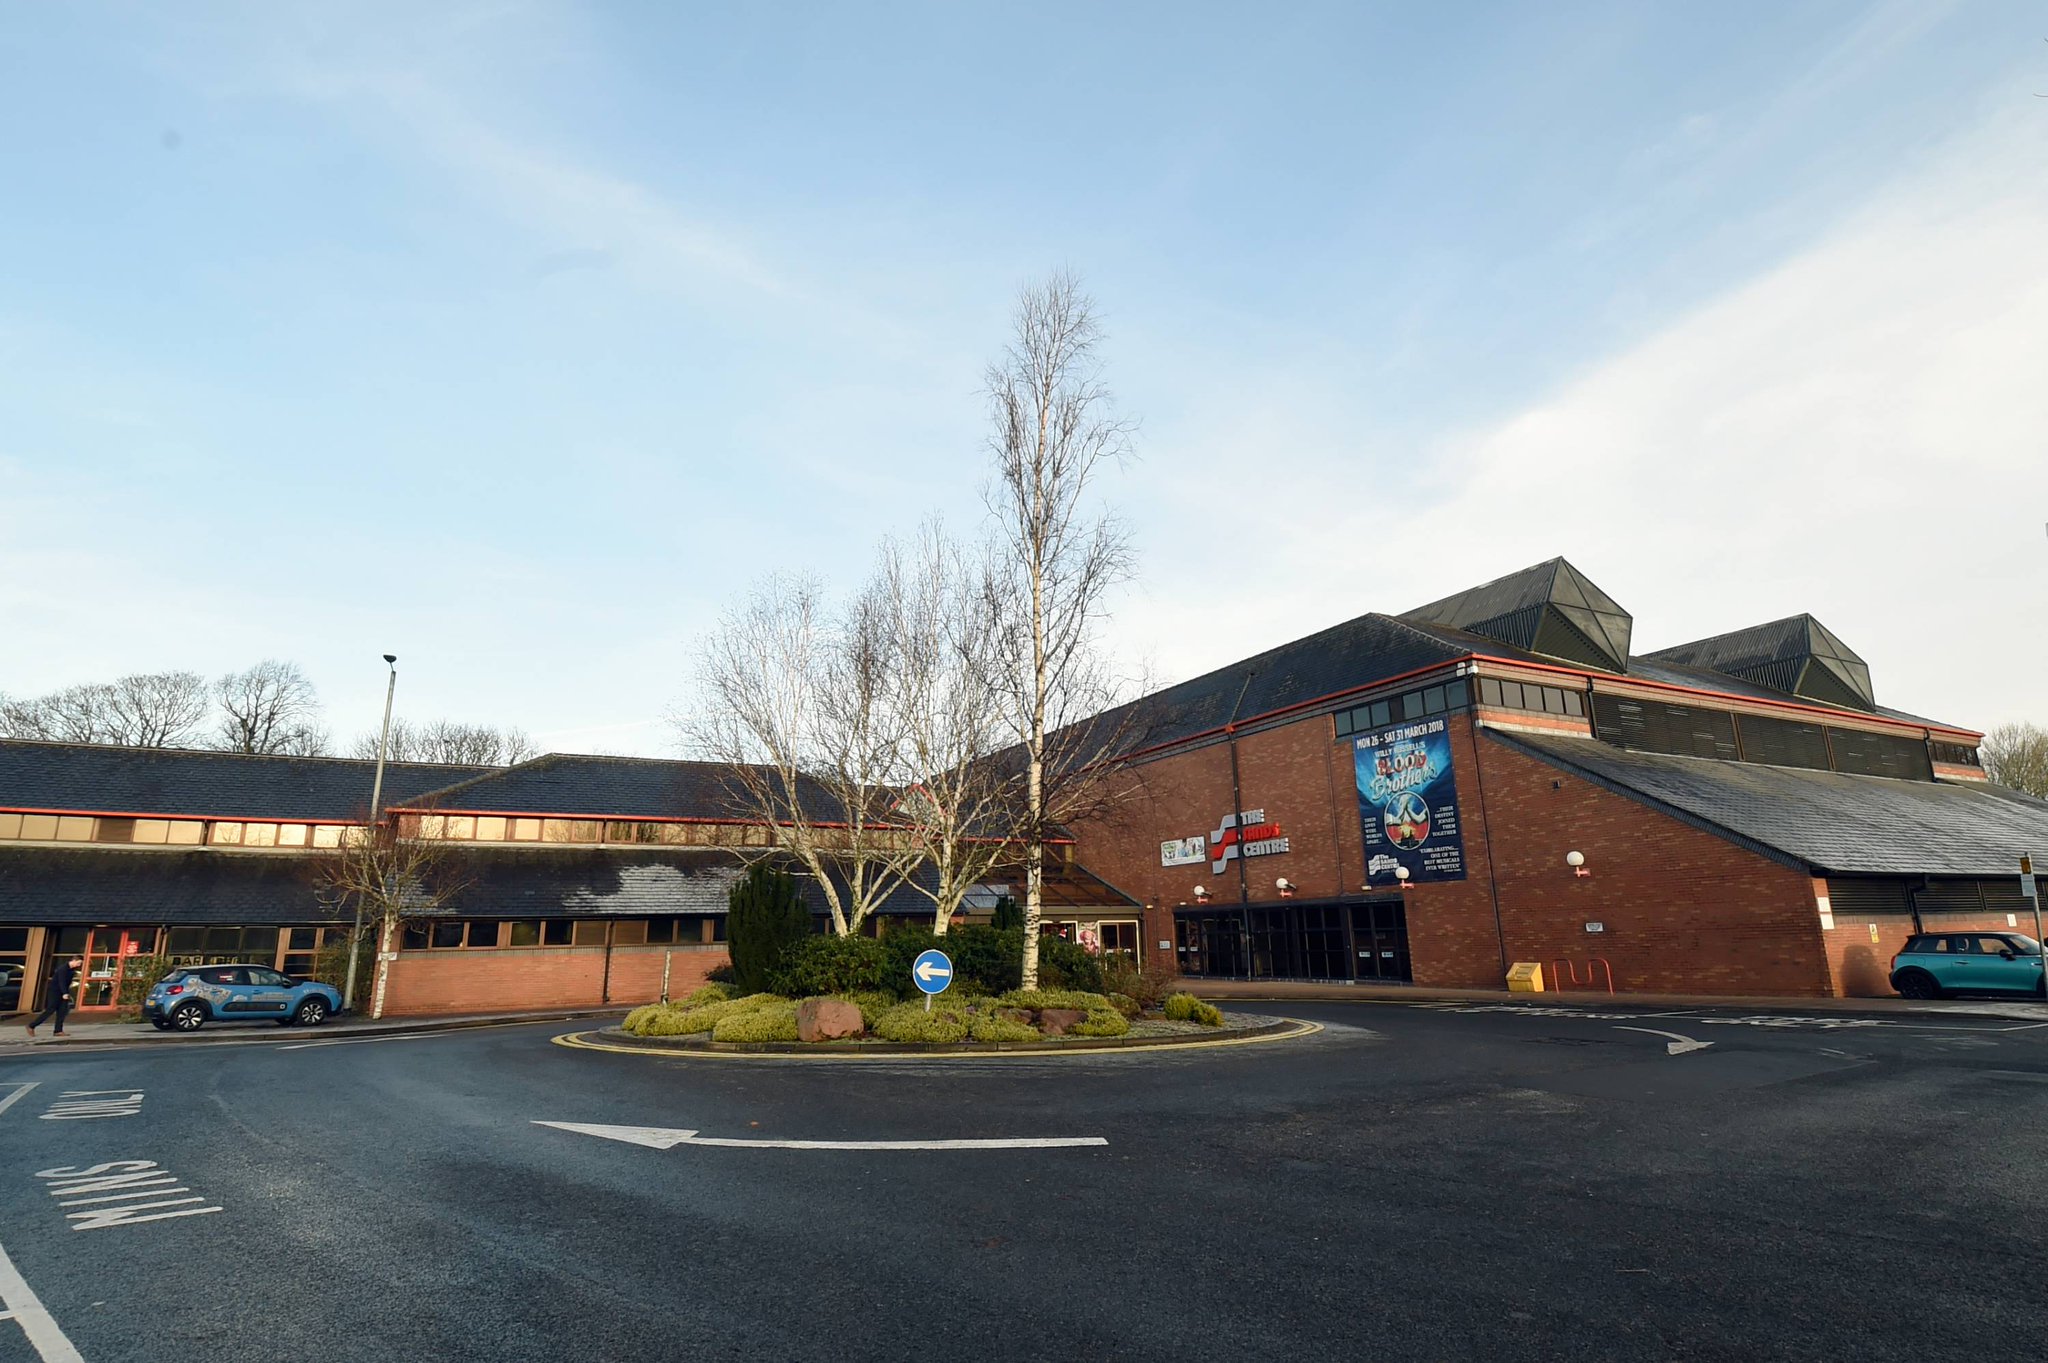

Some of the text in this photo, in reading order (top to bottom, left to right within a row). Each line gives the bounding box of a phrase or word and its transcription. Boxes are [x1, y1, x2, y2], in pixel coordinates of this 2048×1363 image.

[1357, 738, 1370, 750] MON
[1372, 736, 1379, 746] 26
[1384, 731, 1396, 743] SAT
[1396, 730, 1404, 741] 31
[1404, 724, 1428, 740] MARCH
[1428, 720, 1444, 733] 2018
[1376, 750, 1428, 776] BLOOD
[1370, 763, 1438, 801] Brothers
[1241, 808, 1264, 824] THE
[1242, 838, 1289, 857] CENTRE
[34, 1088, 224, 1232] MINS ONLY
